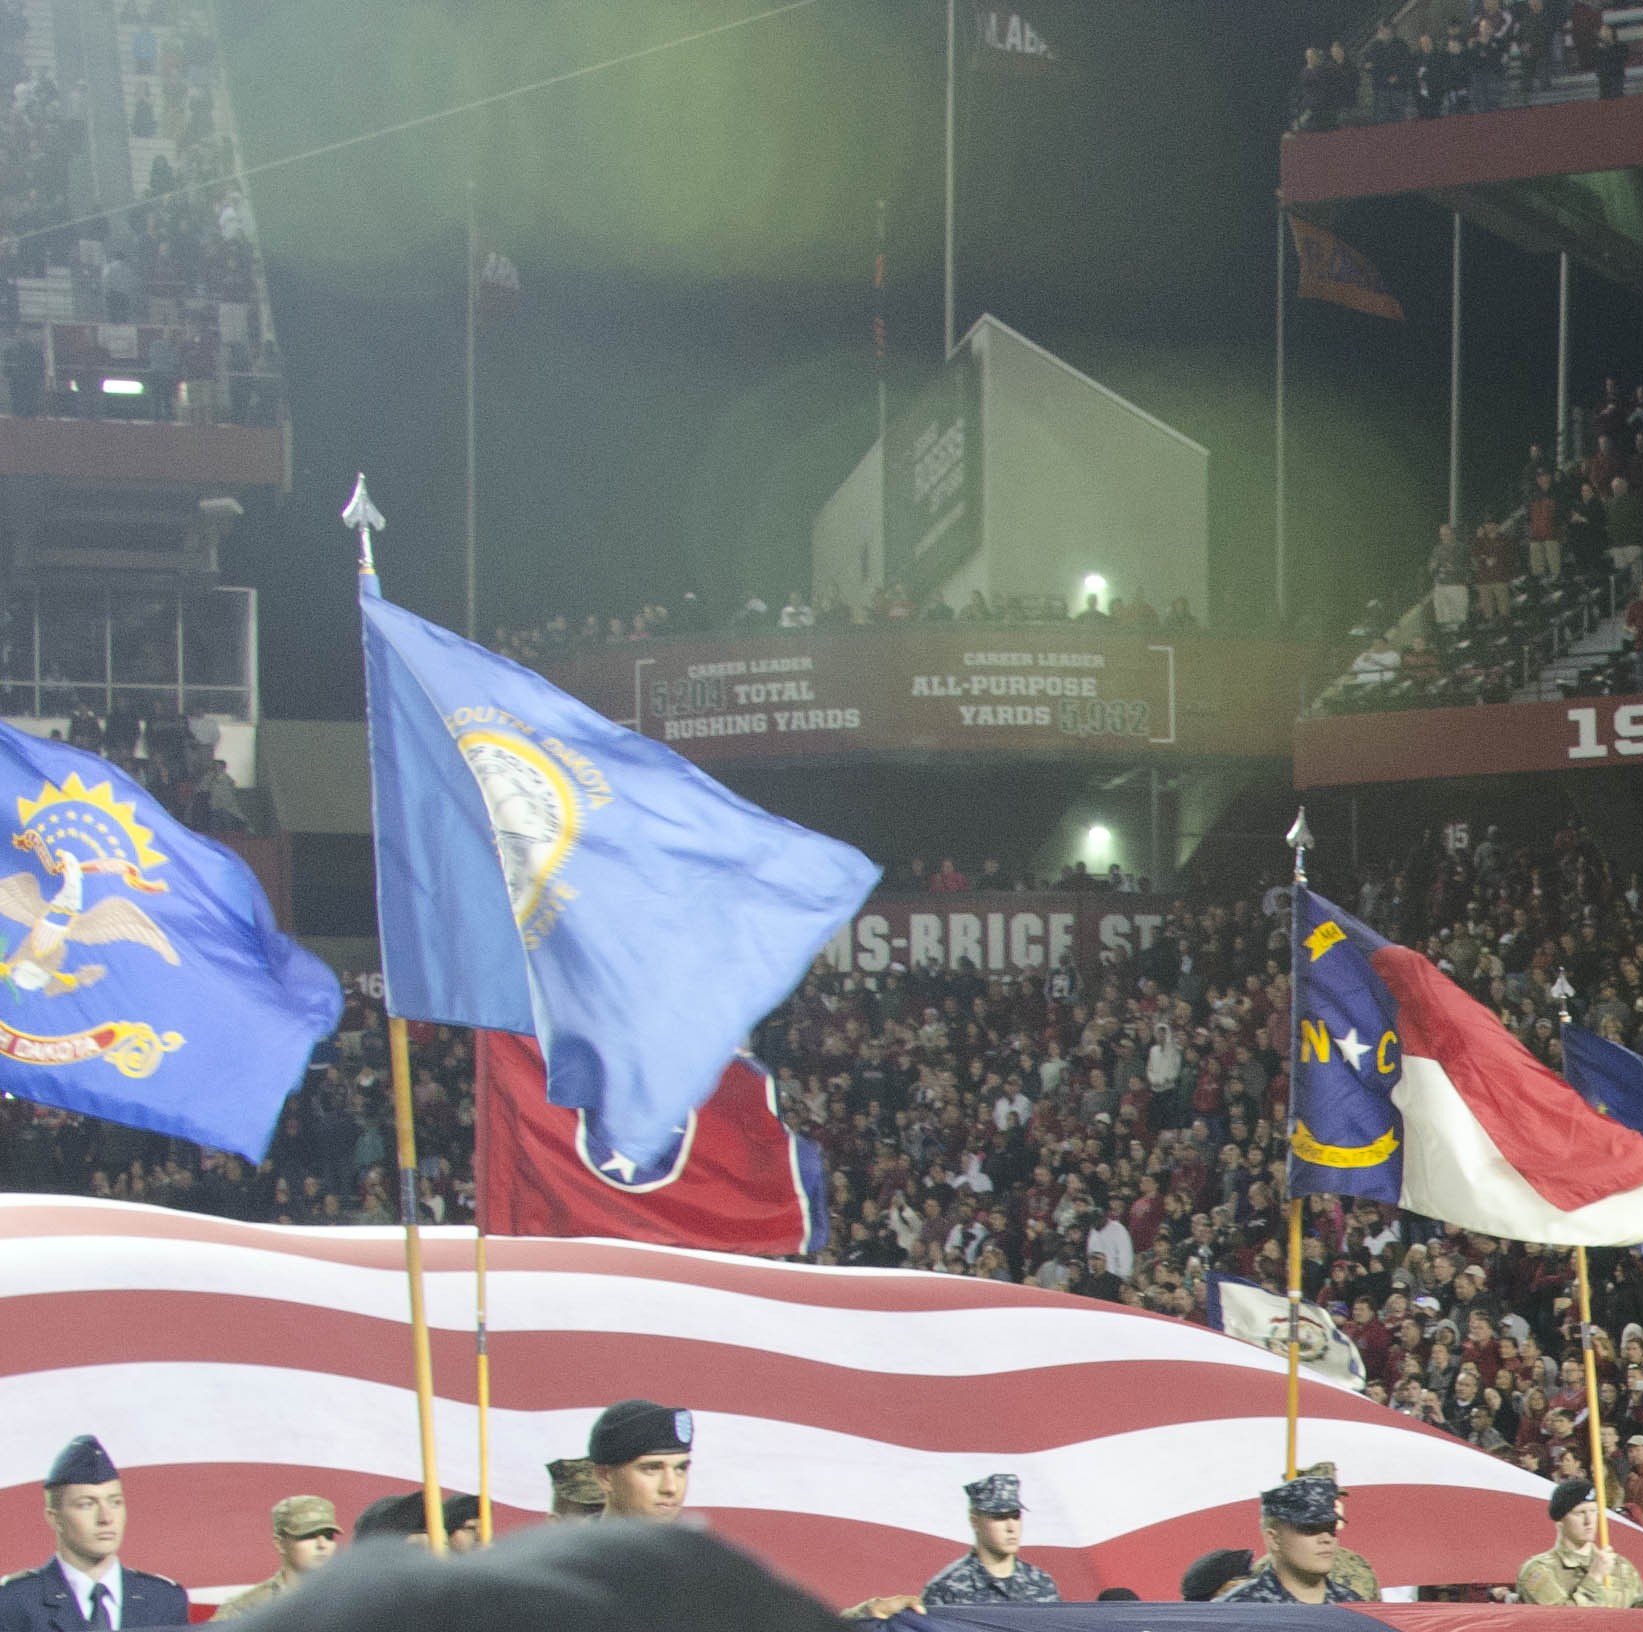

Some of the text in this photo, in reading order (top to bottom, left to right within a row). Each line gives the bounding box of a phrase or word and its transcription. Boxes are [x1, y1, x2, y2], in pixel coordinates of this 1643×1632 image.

[750, 656, 815, 674] LEADER
[733, 680, 816, 705] TOTAL
[911, 675, 1099, 698] ALL-PURPOSE
[663, 707, 861, 741] RUSHING YARDS
[959, 704, 1052, 727] YARDS
[1300, 1018, 1332, 1064] N
[1376, 1030, 1399, 1074] C
